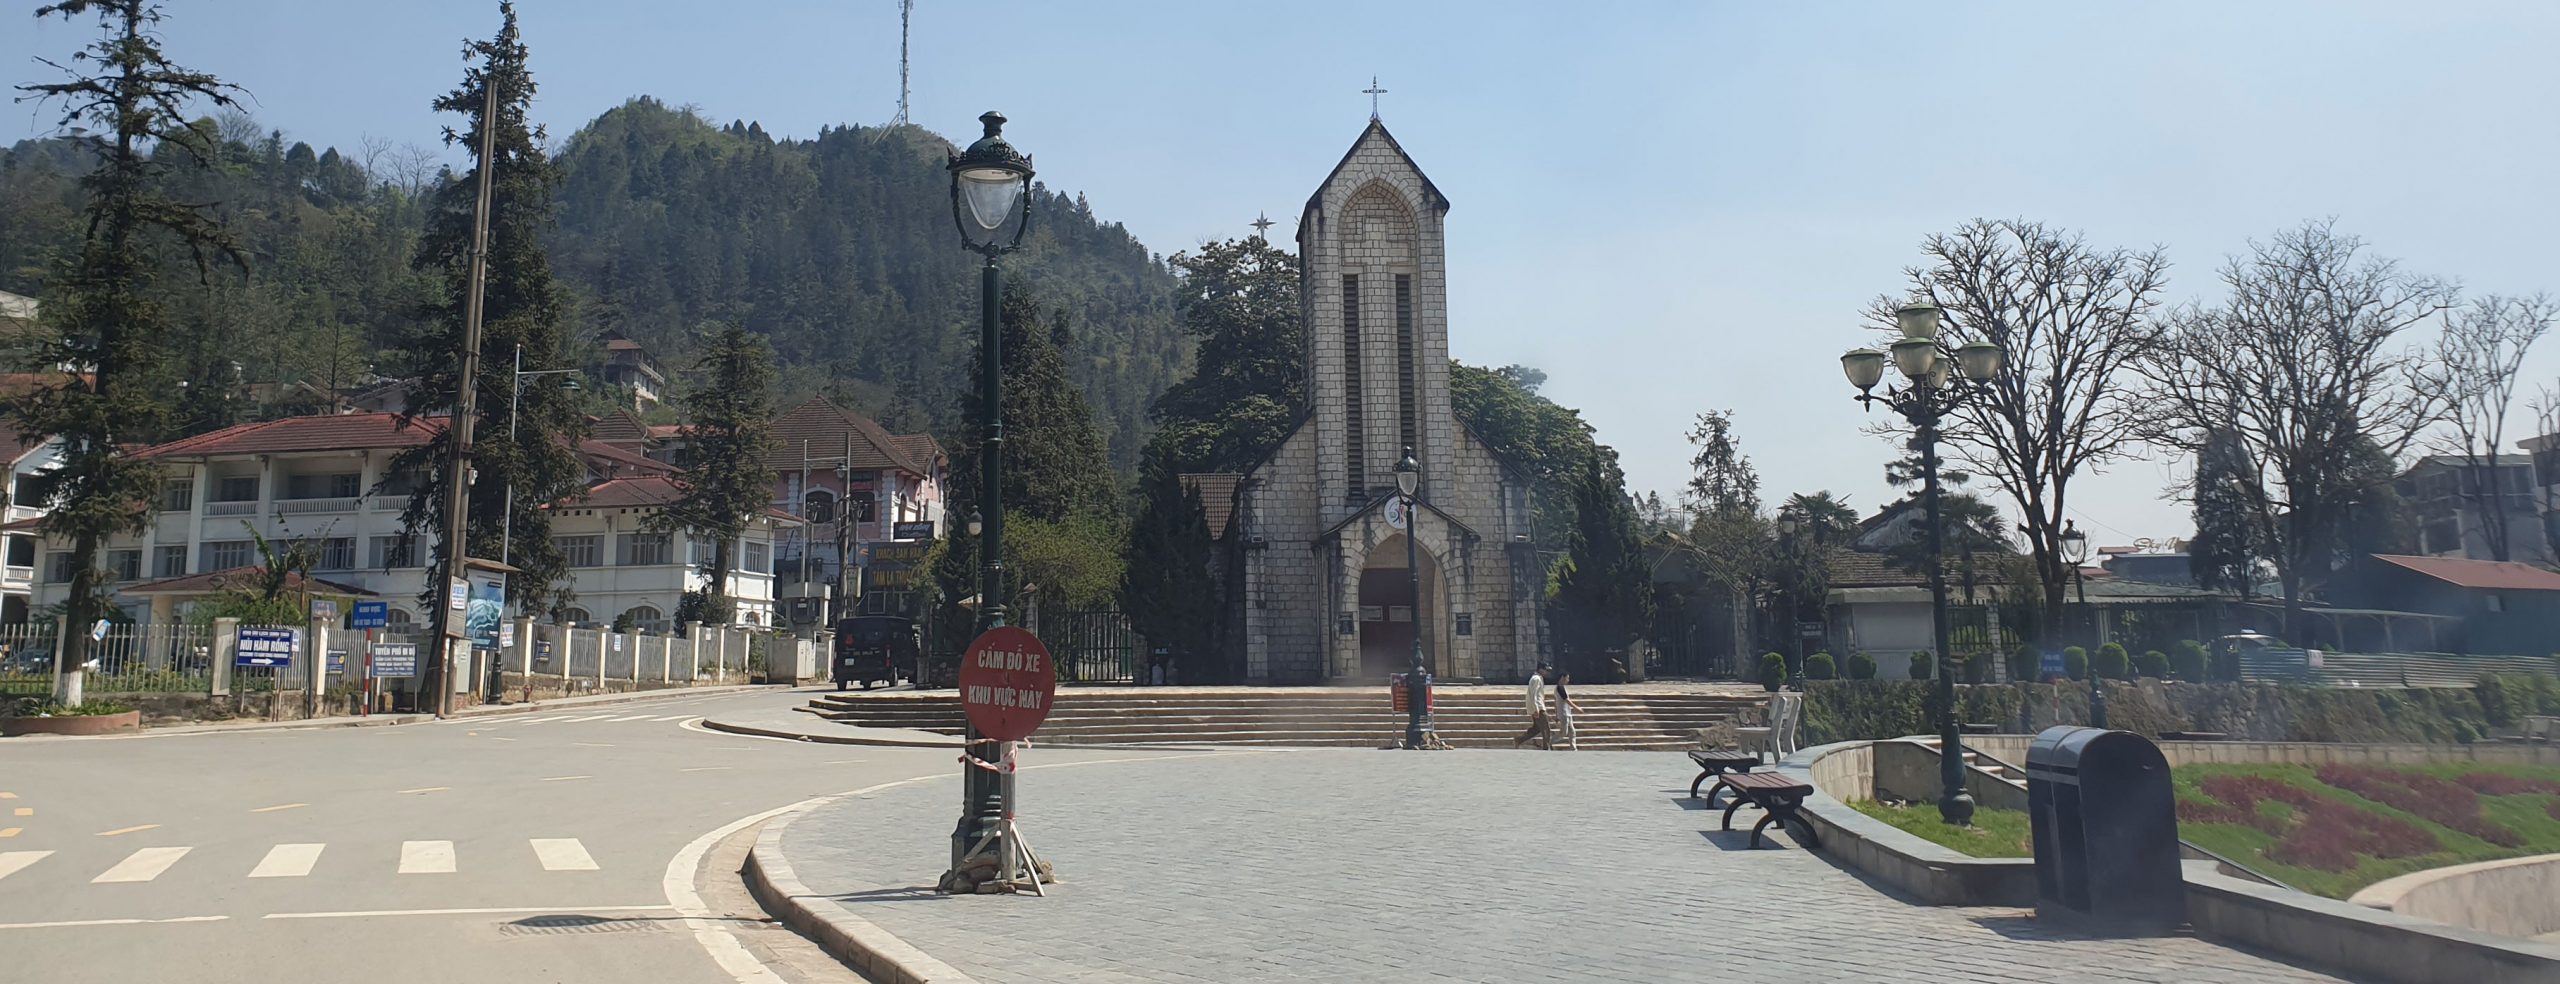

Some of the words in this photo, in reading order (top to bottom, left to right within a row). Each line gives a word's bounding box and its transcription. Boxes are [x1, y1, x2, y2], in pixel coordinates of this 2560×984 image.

[978, 642, 1004, 669] CẤM
[1007, 644, 1023, 671] ĐỖ
[1025, 653, 1041, 672] XE
[968, 685, 991, 705] KHU
[994, 686, 1017, 711] VỰC
[1019, 684, 1043, 709] NÀY
